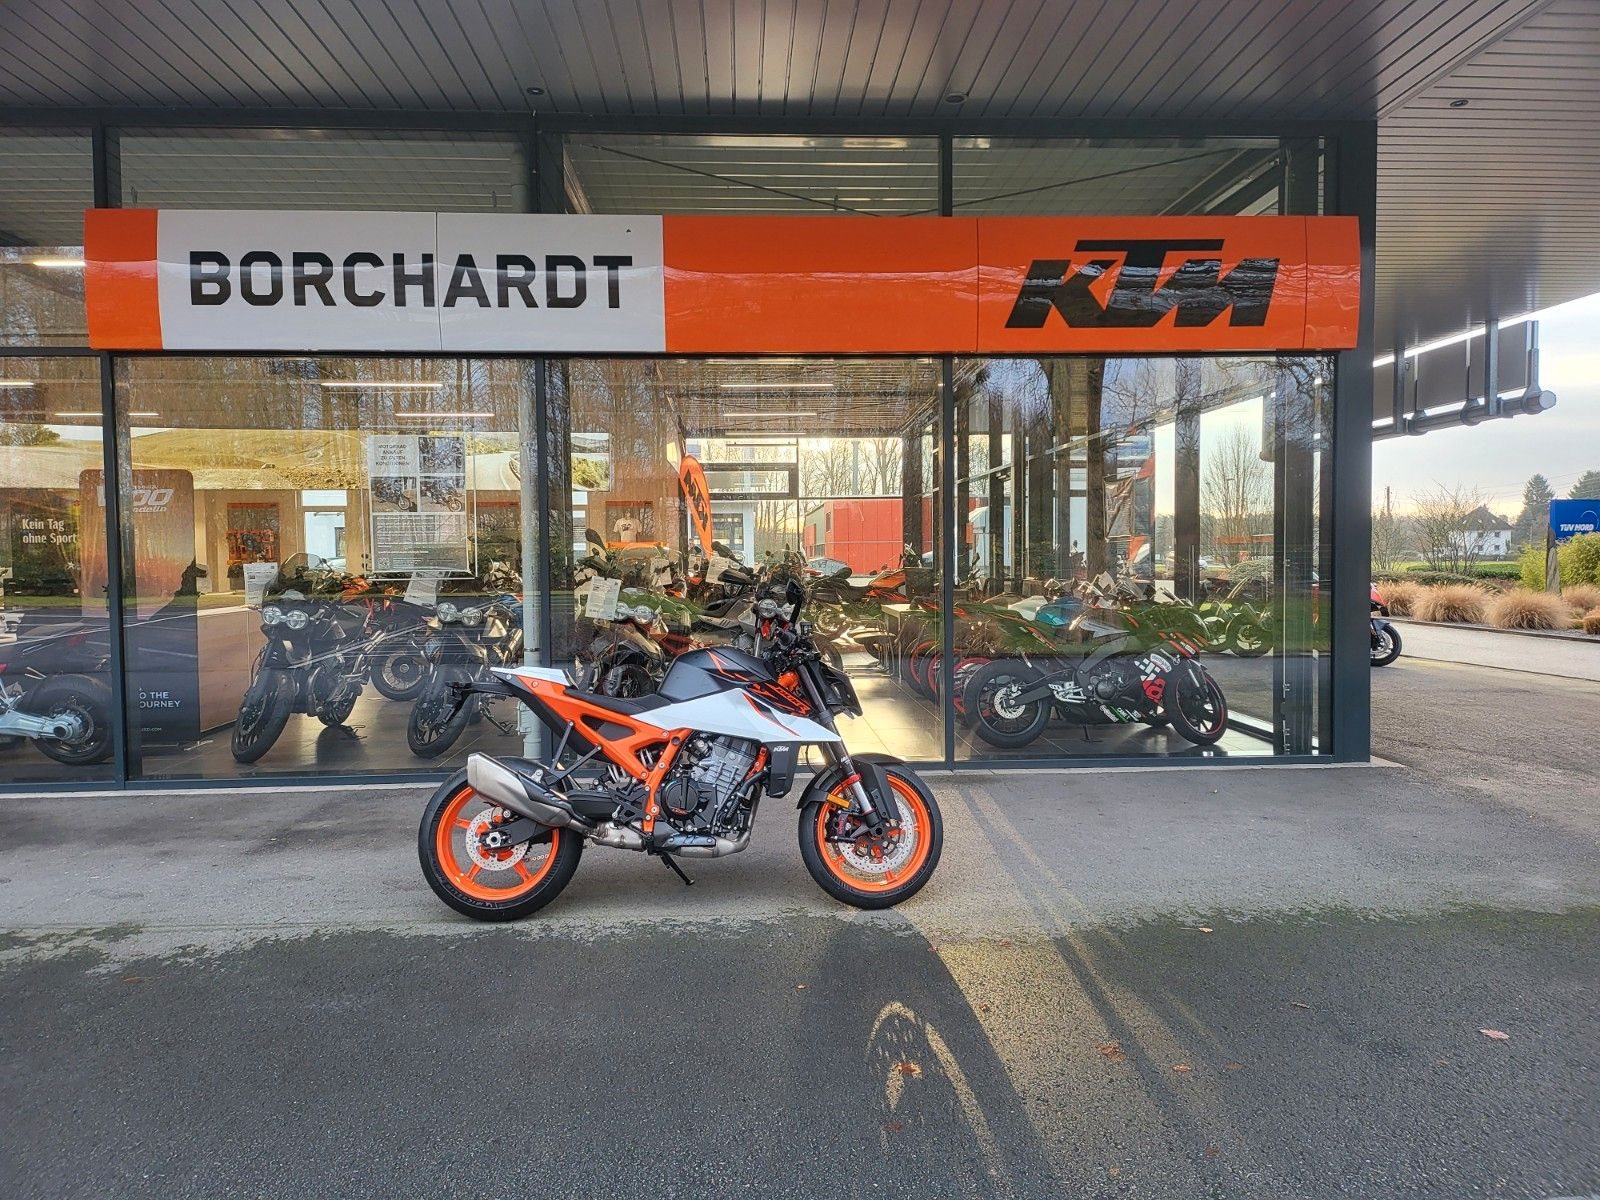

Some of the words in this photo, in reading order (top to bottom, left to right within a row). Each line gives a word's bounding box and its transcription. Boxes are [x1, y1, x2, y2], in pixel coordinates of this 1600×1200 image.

[189, 250, 633, 309] BORCHARDT
[1004, 238, 1281, 329] KTM
[22, 519, 44, 530] Kein
[47, 519, 65, 532] Tag
[22, 533, 47, 544] ohne
[50, 533, 77, 546] Sport
[150, 691, 169, 699] THE
[139, 700, 181, 709] OURNEY
[773, 745, 790, 753] KTM
